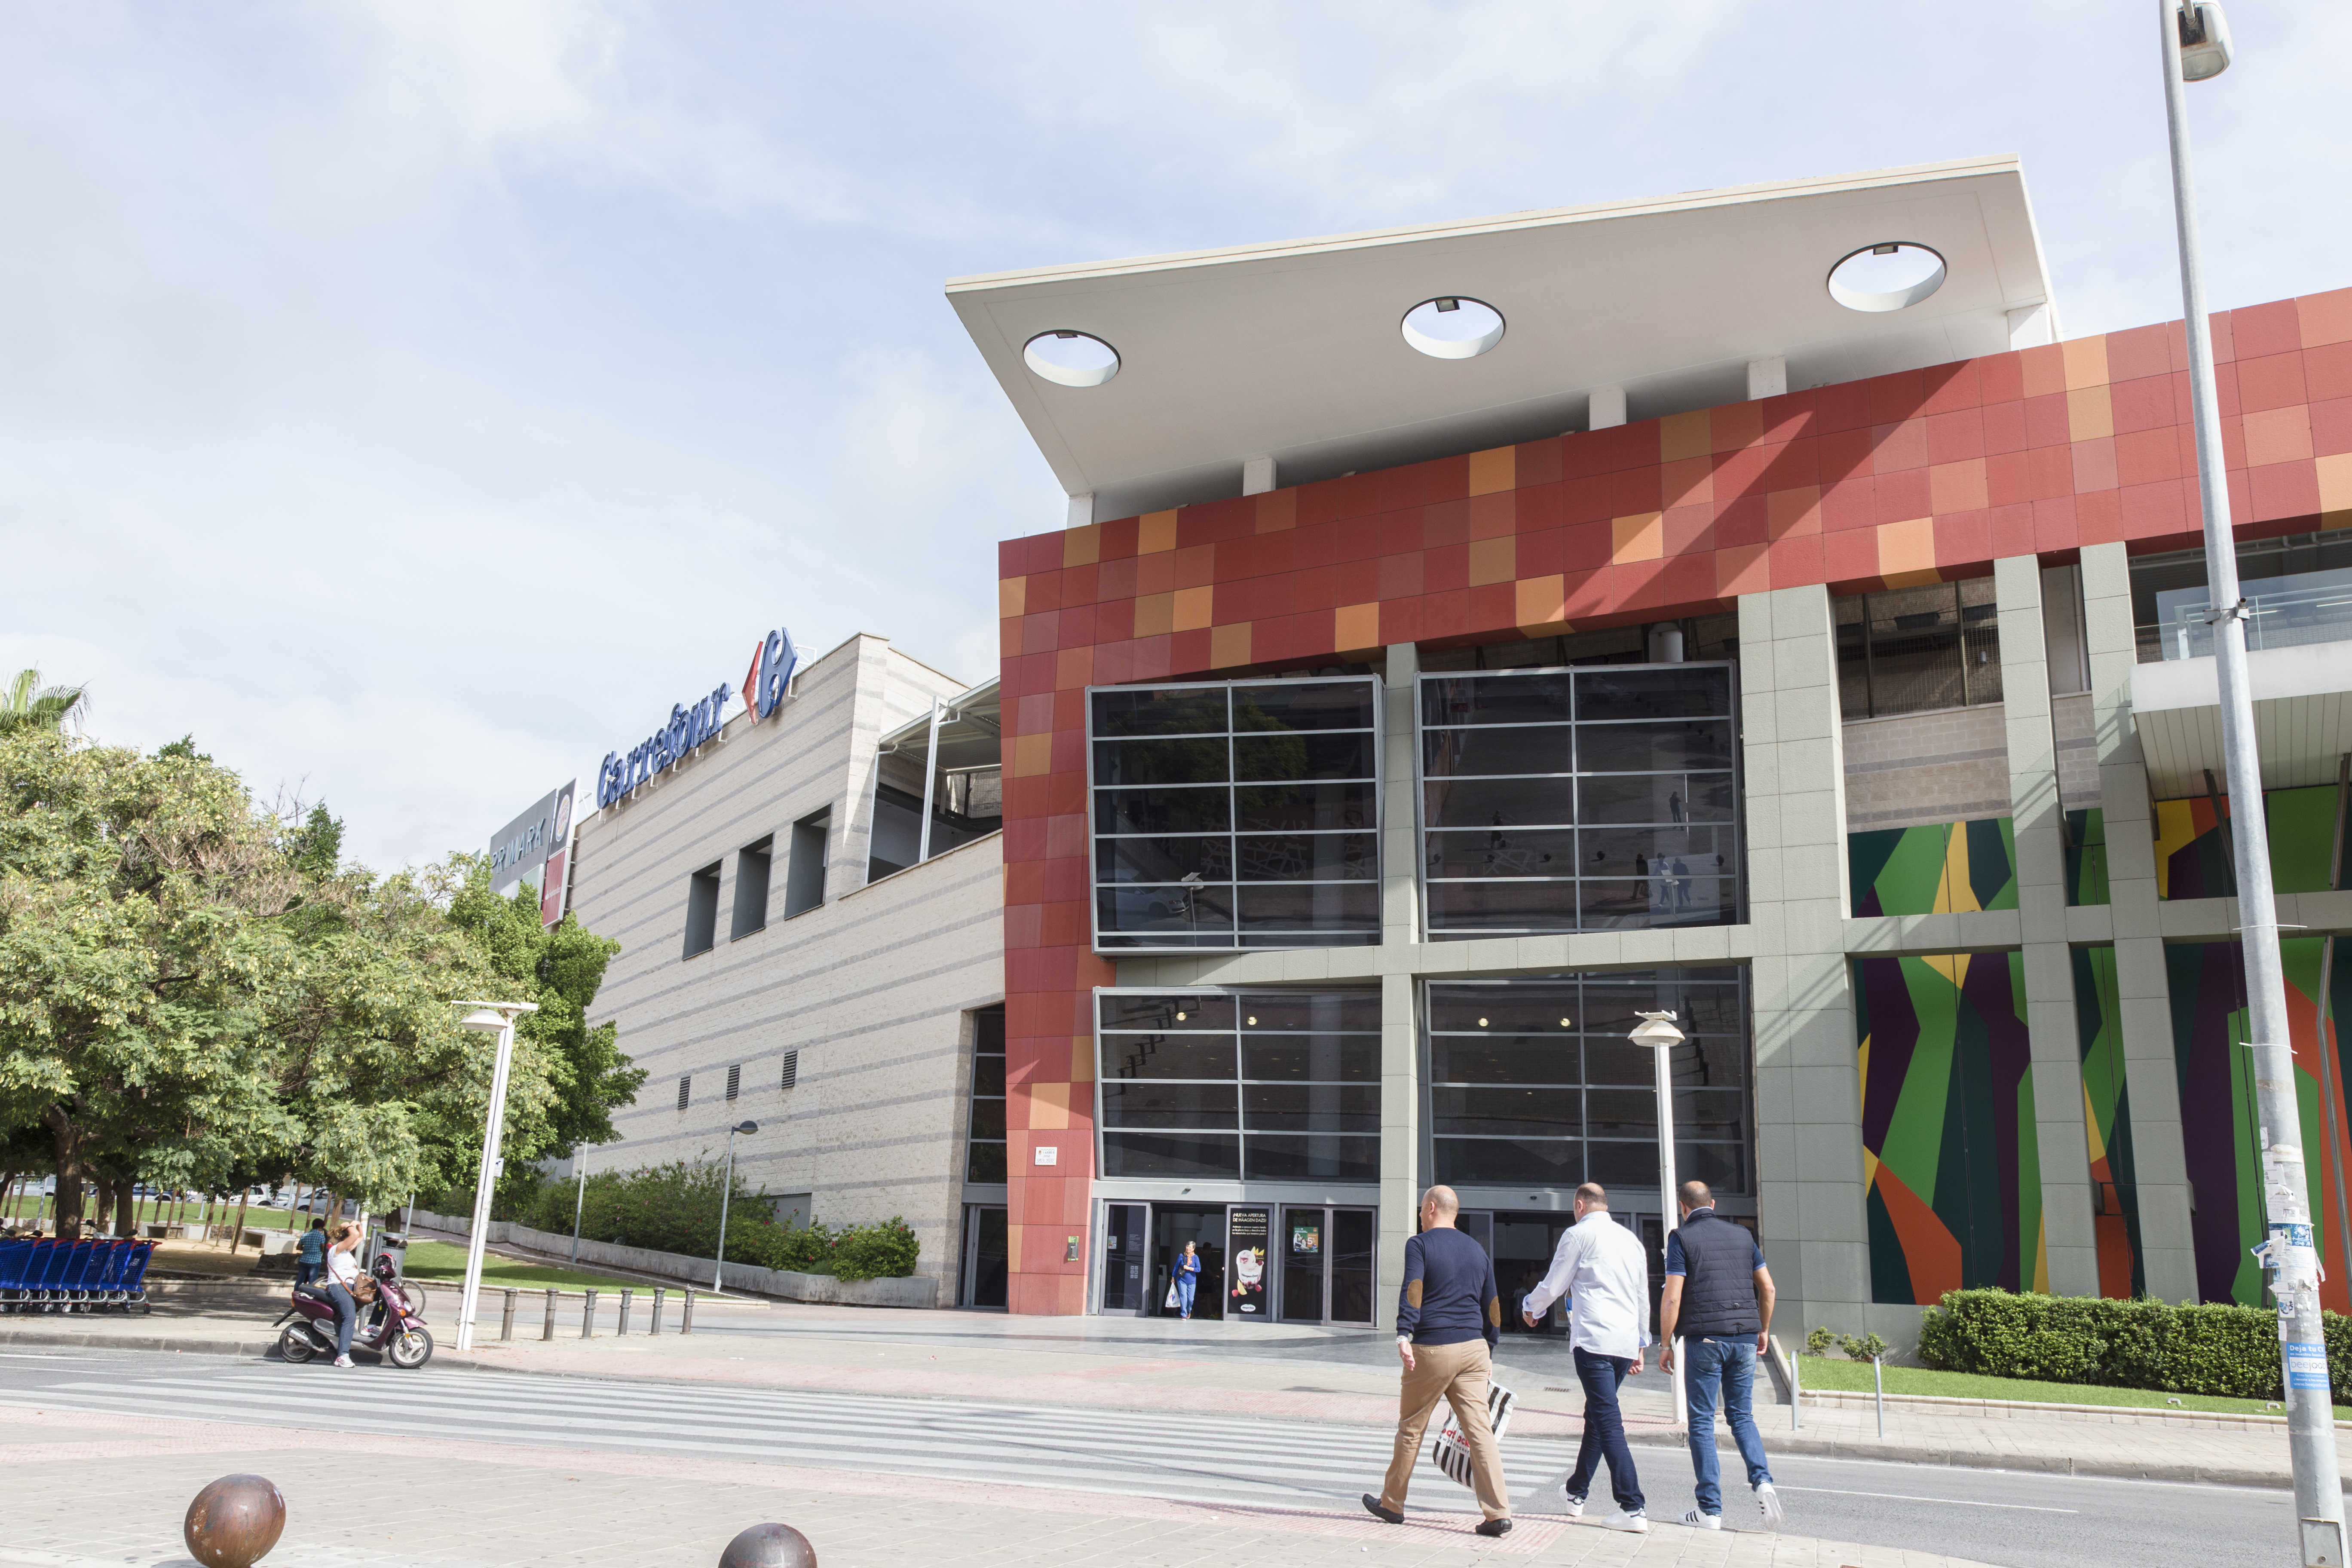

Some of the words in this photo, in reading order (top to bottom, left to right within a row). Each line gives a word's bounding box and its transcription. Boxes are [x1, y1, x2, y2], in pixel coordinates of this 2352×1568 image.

[597, 682, 731, 809] Carrefour
[492, 818, 546, 874] PRIMARK
[2290, 1344, 2306, 1353] Deja
